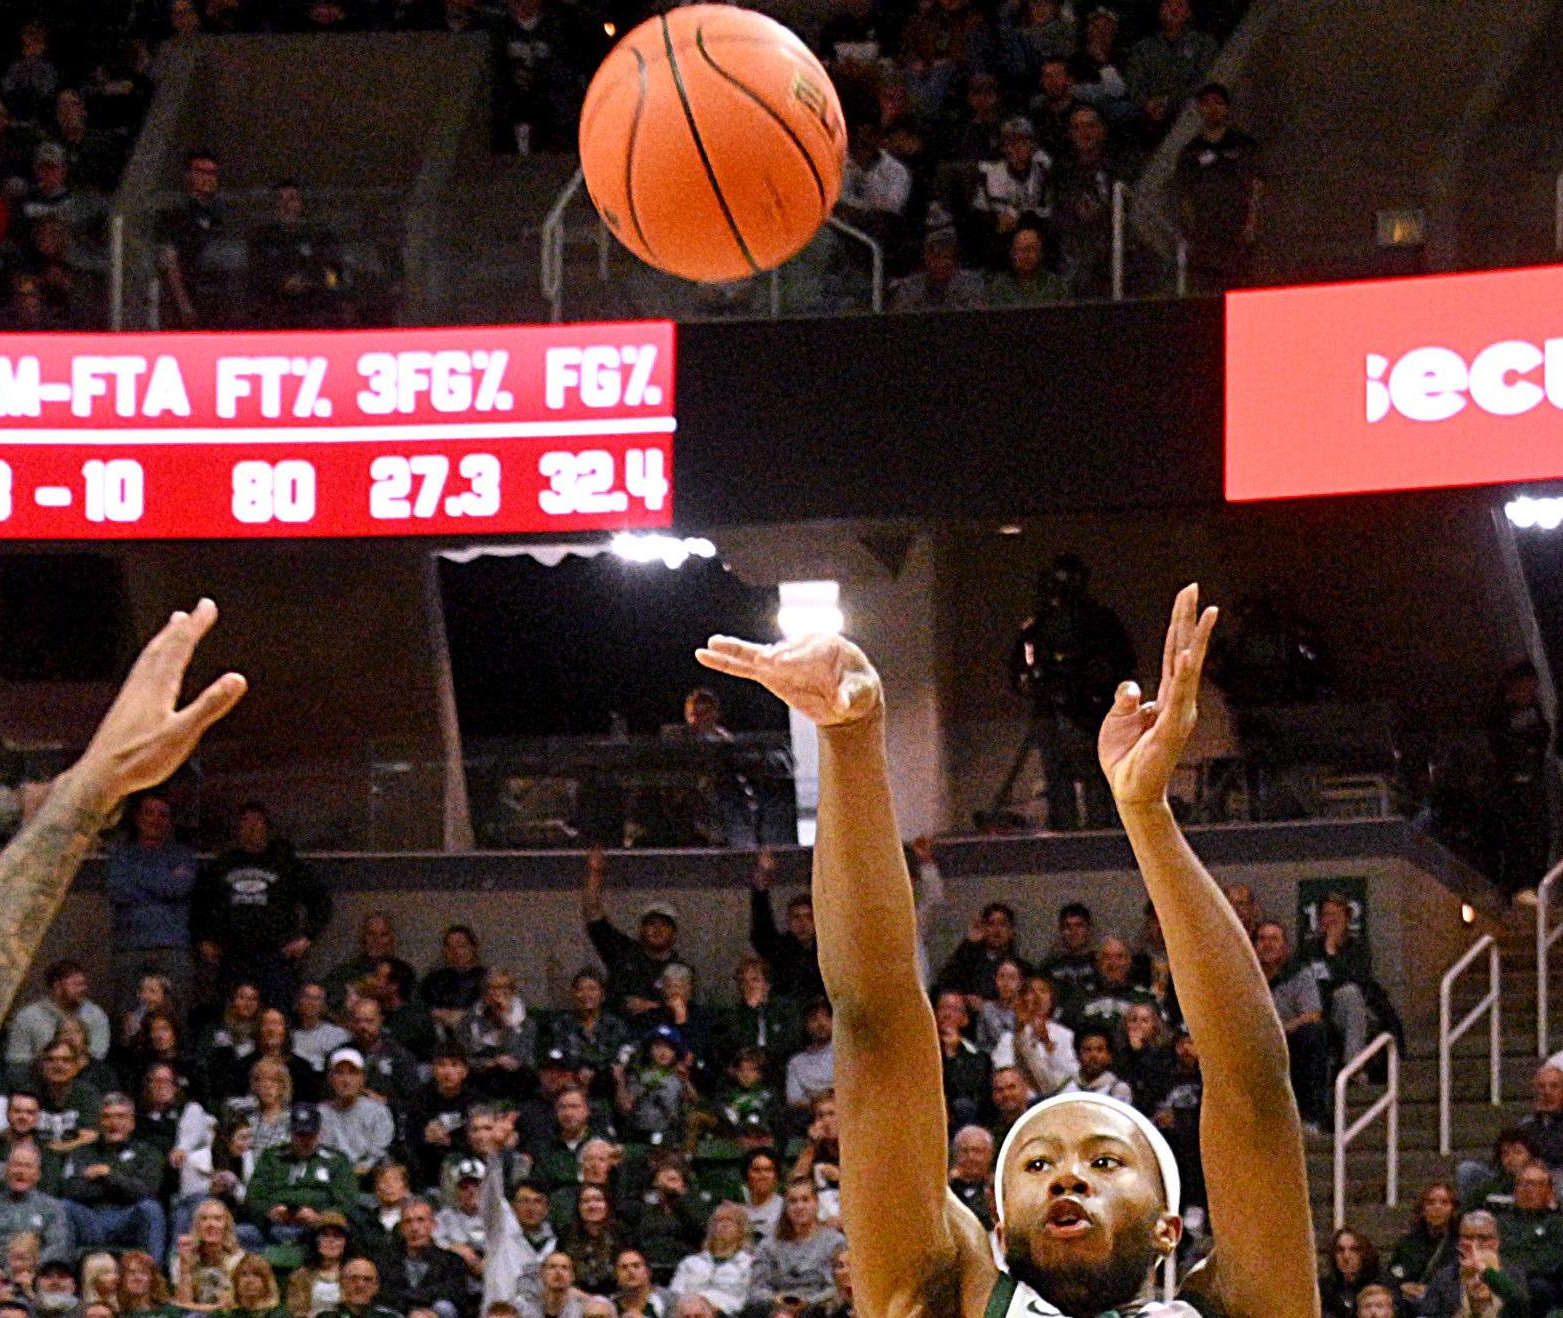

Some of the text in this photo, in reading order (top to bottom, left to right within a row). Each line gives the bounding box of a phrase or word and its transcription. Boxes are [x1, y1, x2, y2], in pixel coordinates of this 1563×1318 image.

[216, 356, 332, 418] FT%
[357, 350, 513, 414] 3FG%
[545, 345, 662, 409] FG%
[82, 459, 144, 522] 10
[232, 460, 315, 522] 80
[370, 454, 500, 519] 27.3
[539, 448, 668, 514] 32.4
